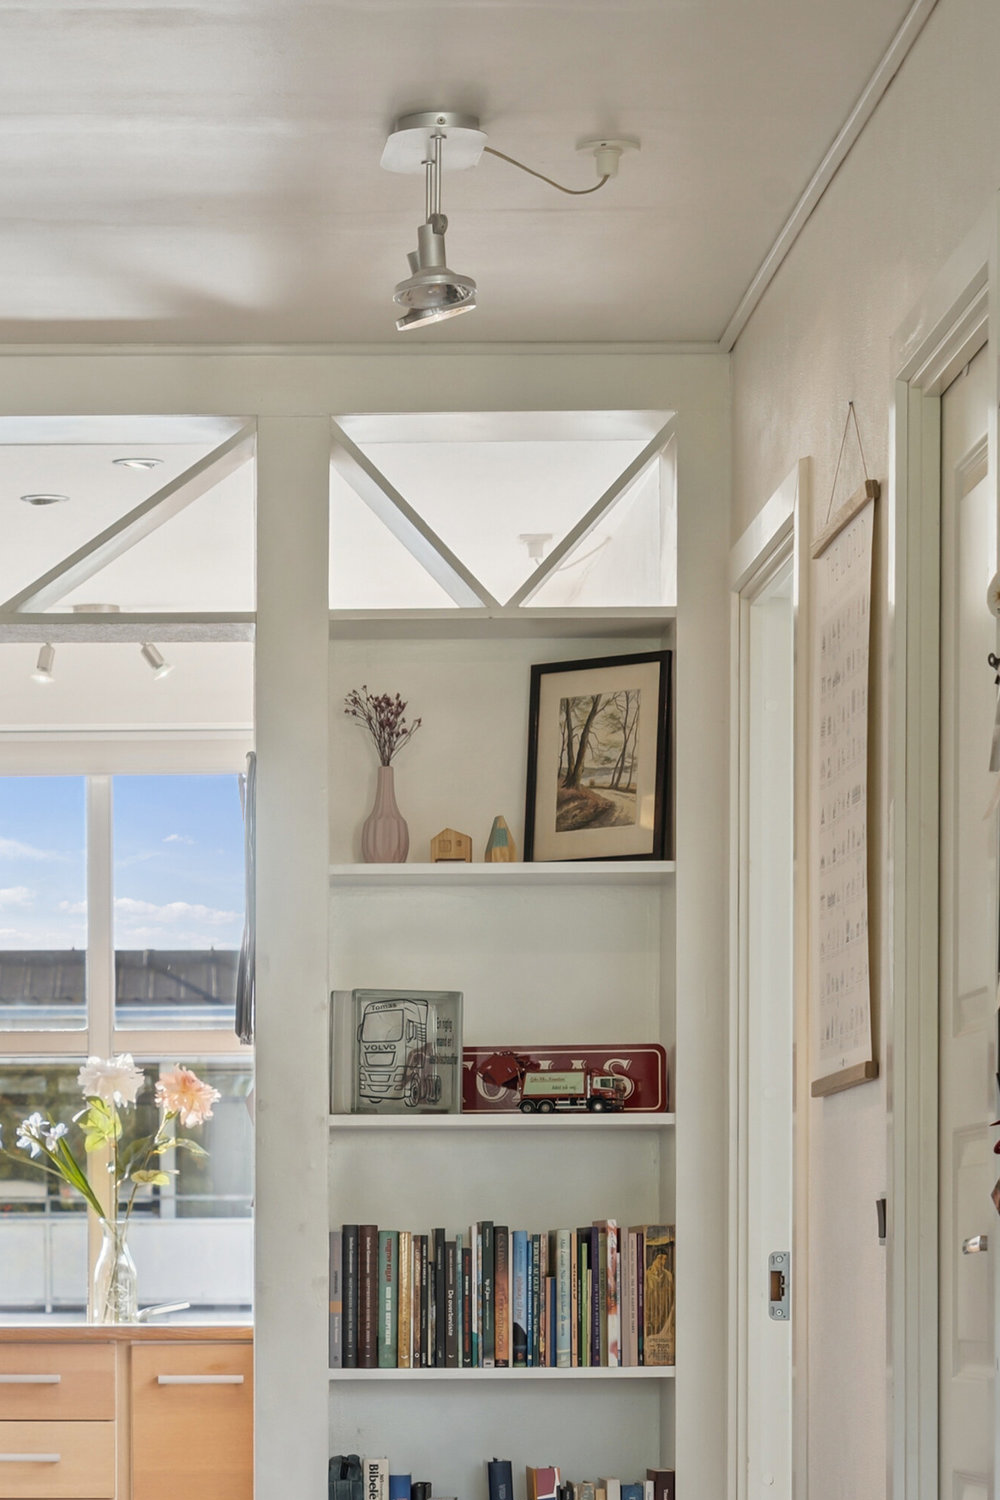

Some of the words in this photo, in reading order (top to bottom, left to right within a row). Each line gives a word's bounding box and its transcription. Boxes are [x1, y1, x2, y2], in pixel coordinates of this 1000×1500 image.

[371, 1002, 398, 1011] Tomas
[364, 1043, 397, 1051] VOLVO
[448, 1289, 455, 1298] De
[448, 1299, 456, 1336] overbeviste
